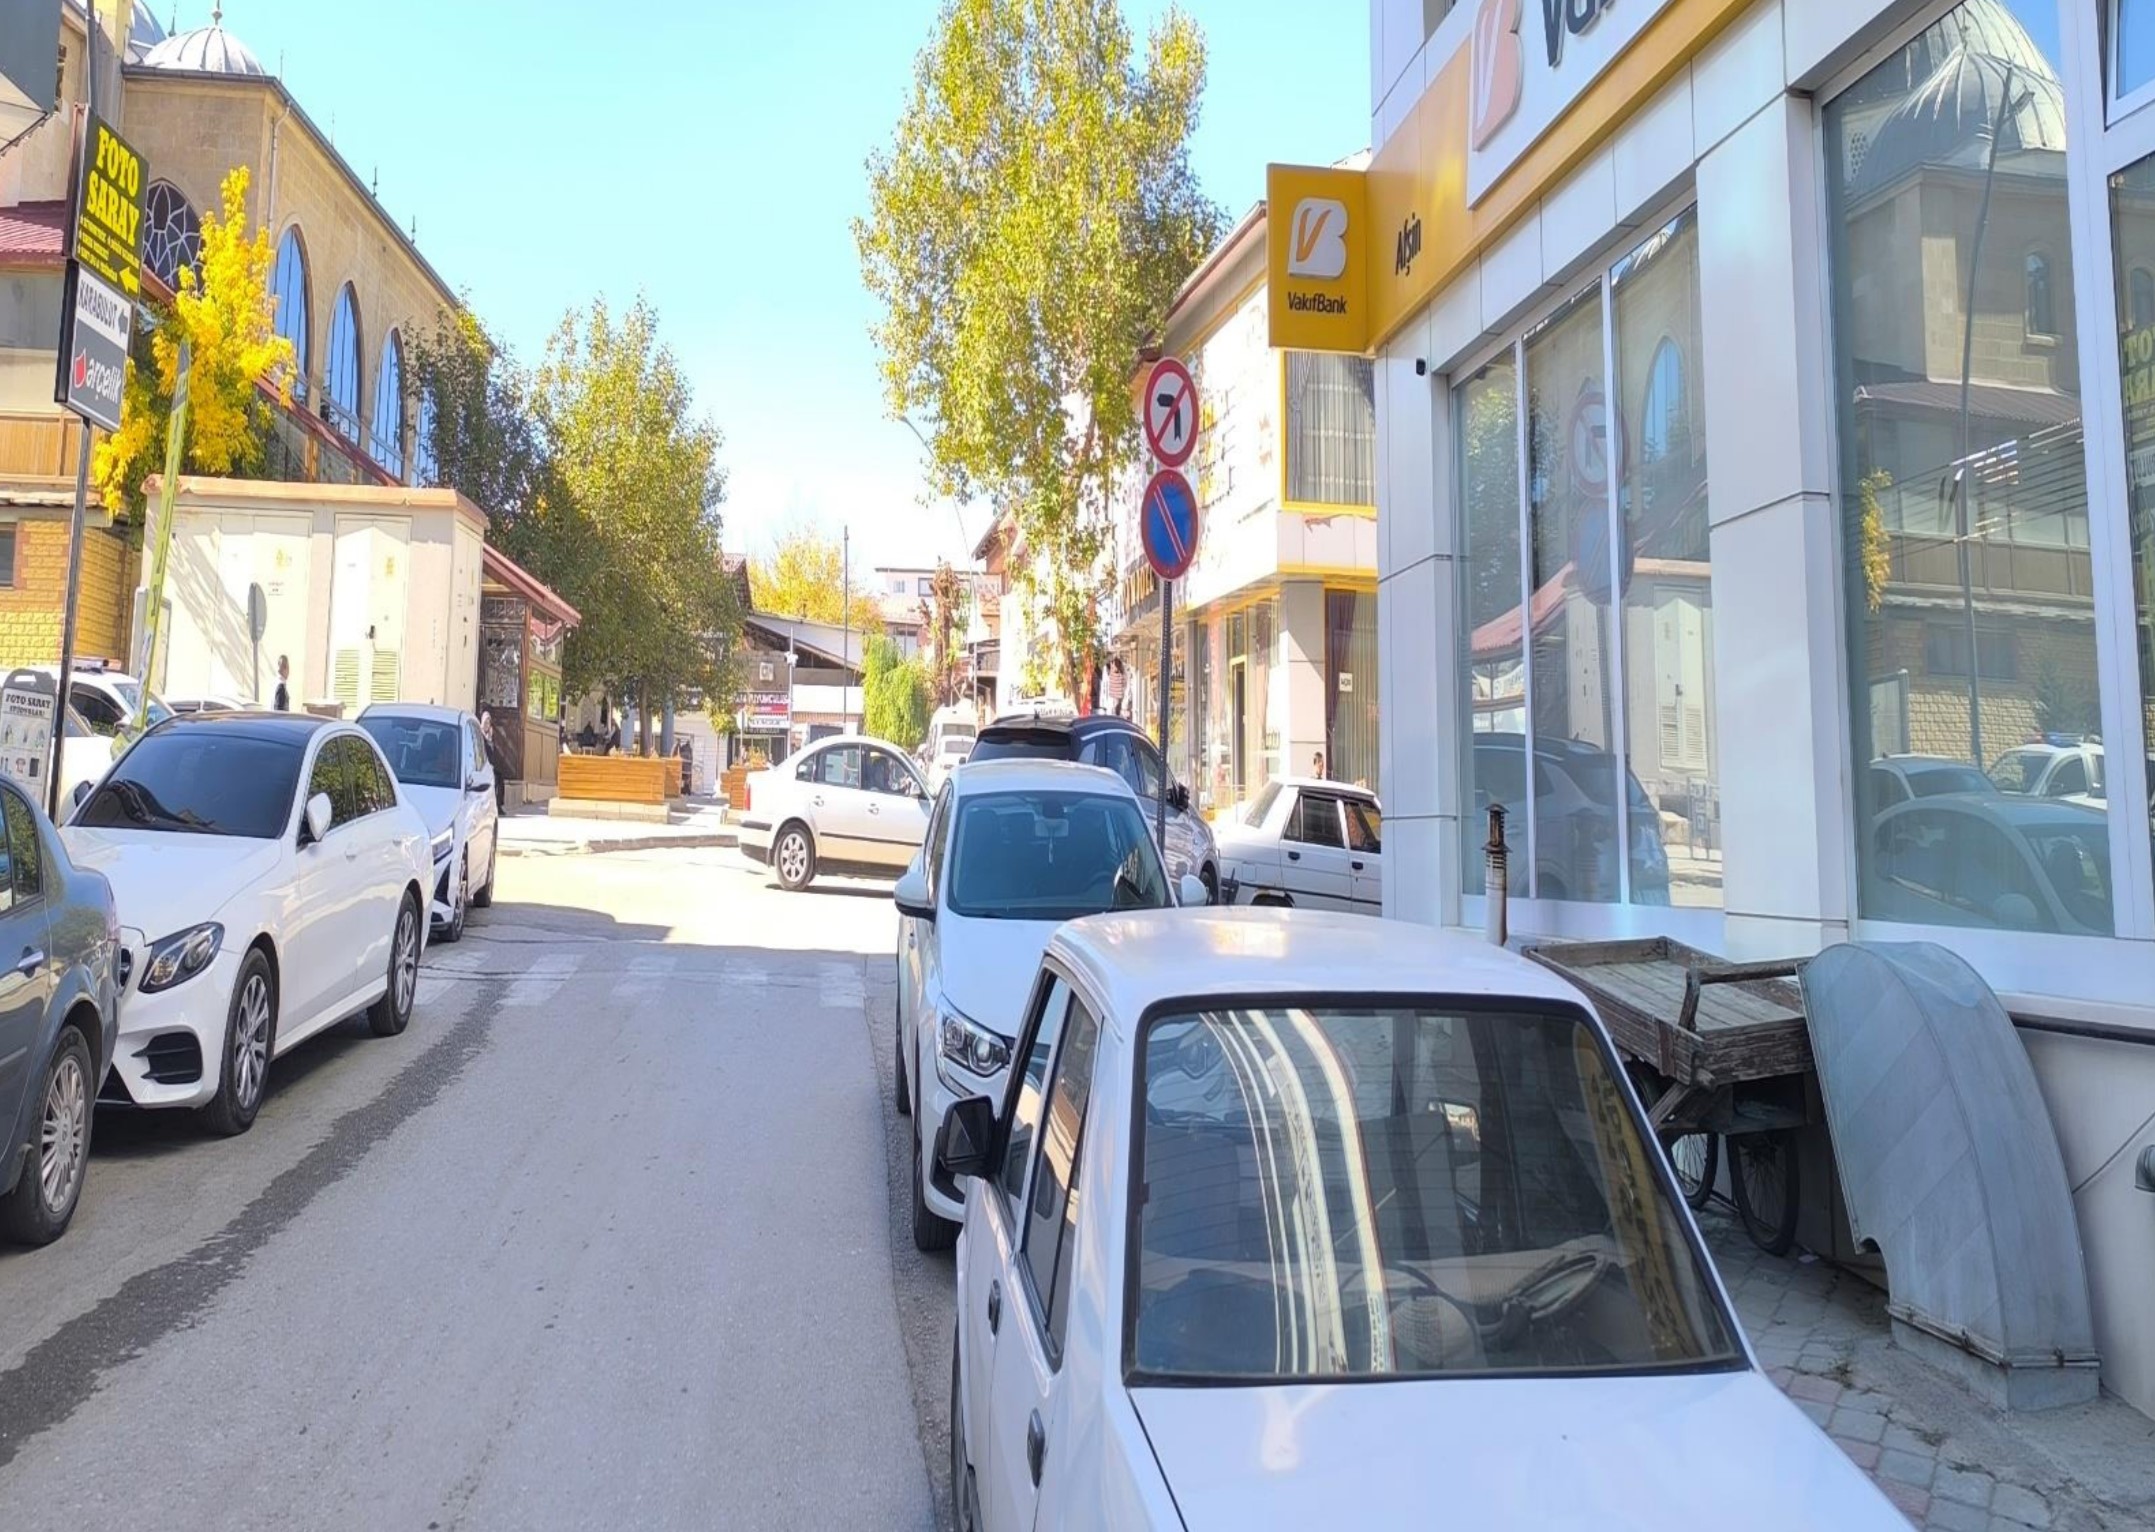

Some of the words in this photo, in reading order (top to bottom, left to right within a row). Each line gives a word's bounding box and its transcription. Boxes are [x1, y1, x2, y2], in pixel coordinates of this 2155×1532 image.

[1542, 0, 1606, 67] Va
[96, 126, 139, 197] FOTO
[86, 170, 140, 247] SARAY
[1395, 212, 1421, 277] Afşin
[78, 279, 117, 330] KARABULUT
[1288, 291, 1346, 314] VakıfBank
[86, 356, 121, 405] arçelik
